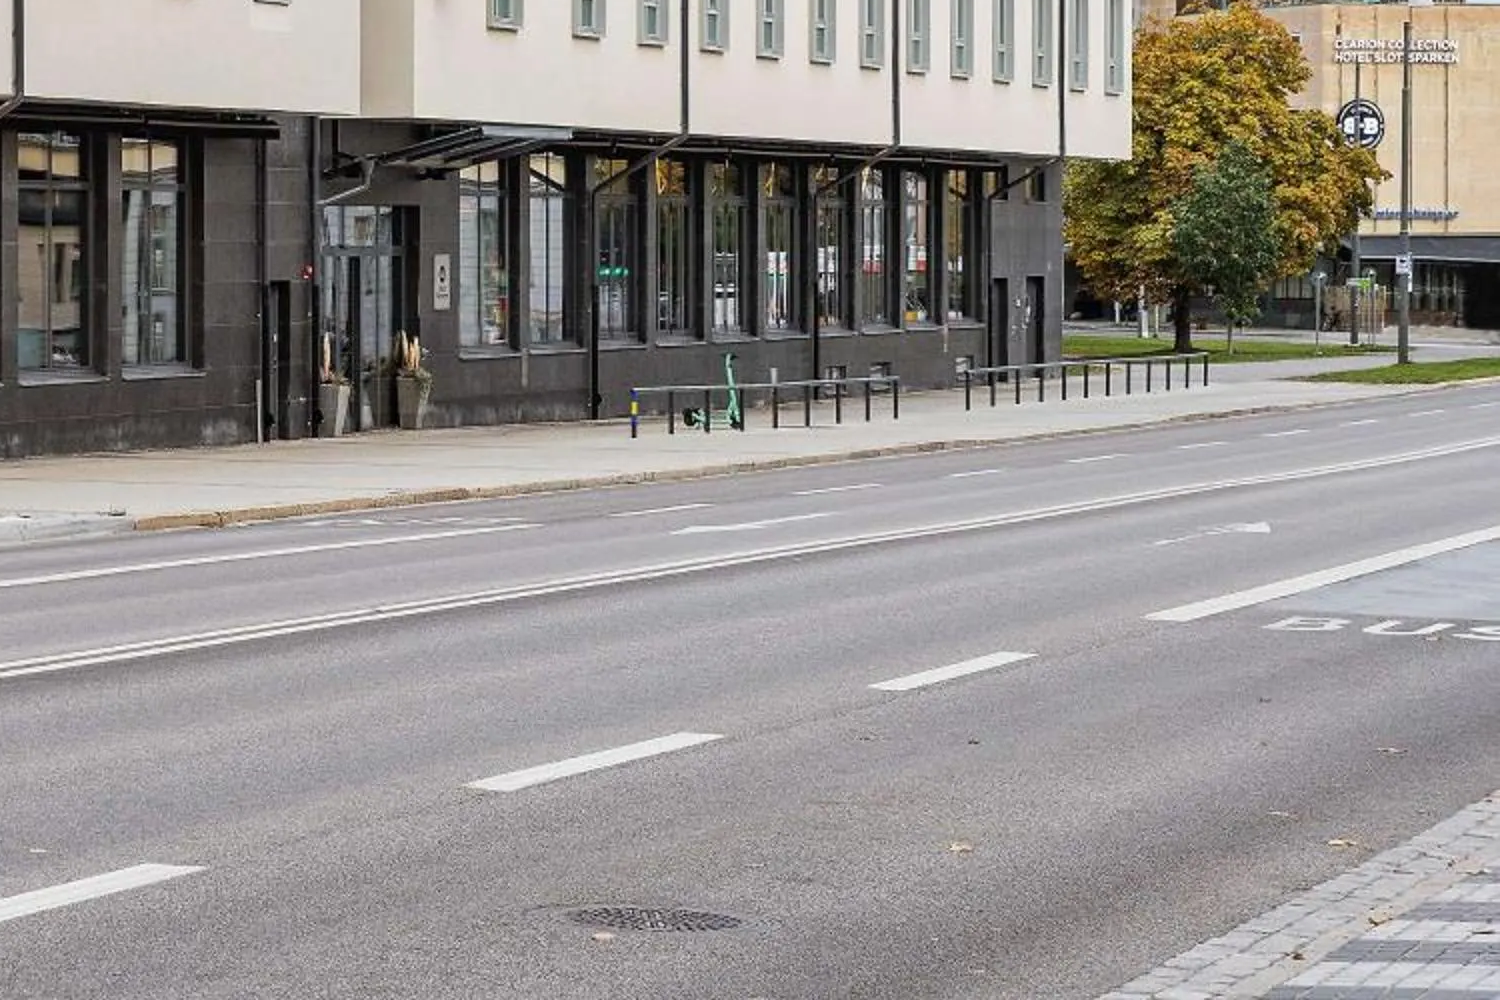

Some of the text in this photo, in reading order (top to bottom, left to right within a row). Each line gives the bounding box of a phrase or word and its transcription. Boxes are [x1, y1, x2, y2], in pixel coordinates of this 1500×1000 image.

[1334, 39, 1458, 51] CLARION COLECTION
[1334, 52, 1459, 63] HOTEL SLOTSPARKEN
